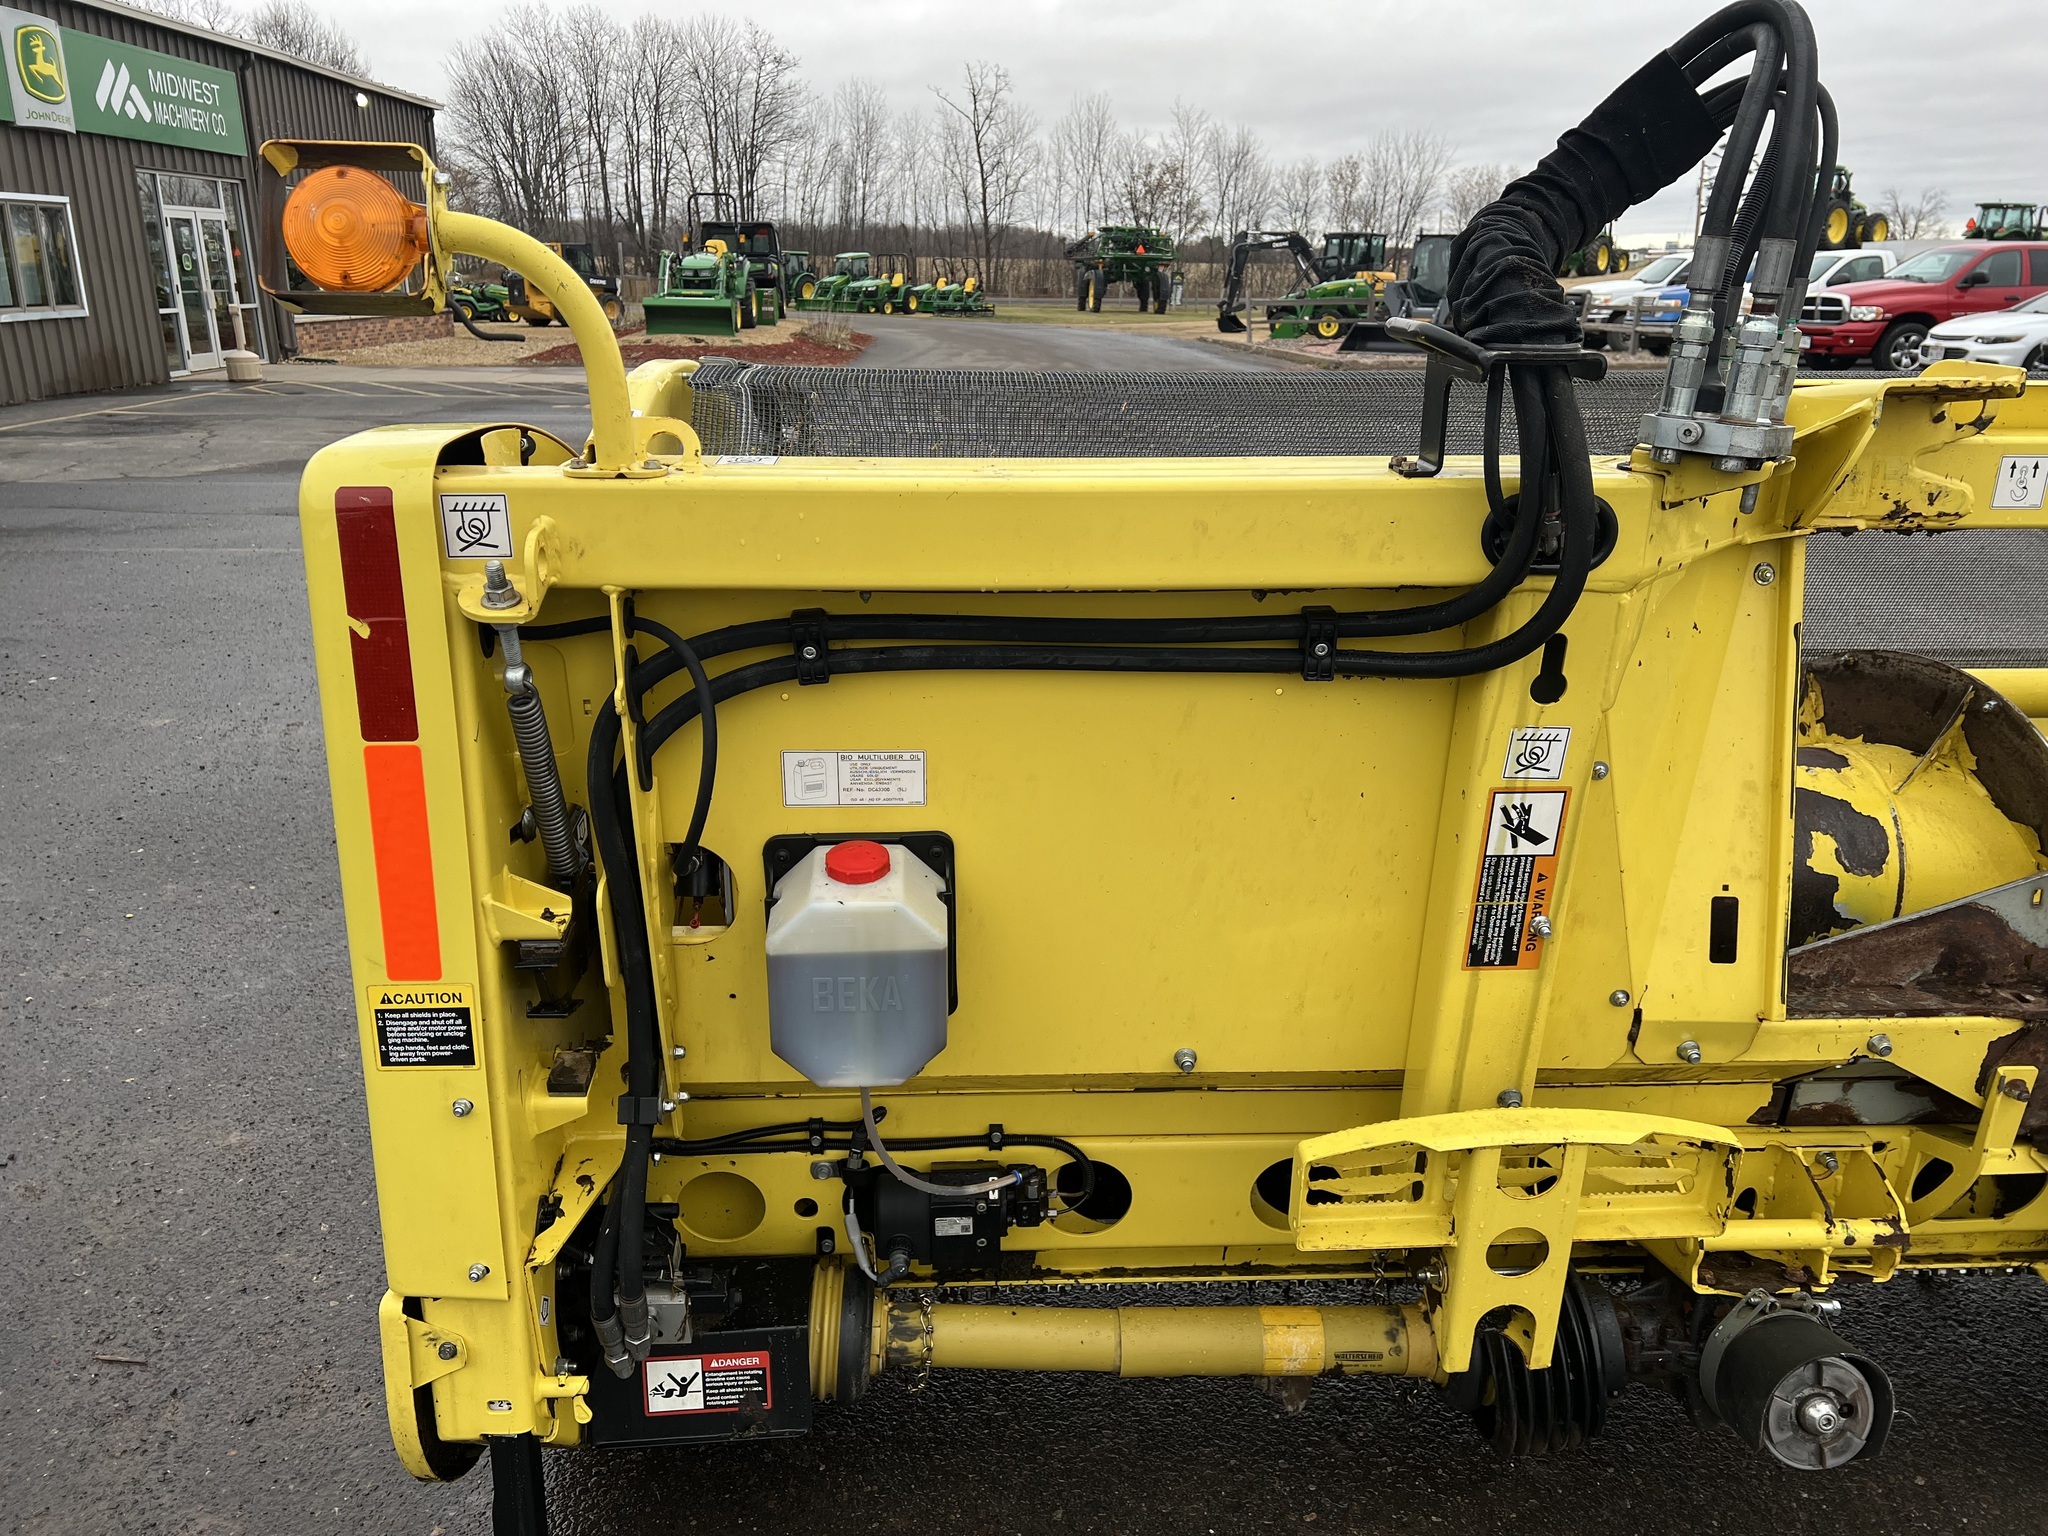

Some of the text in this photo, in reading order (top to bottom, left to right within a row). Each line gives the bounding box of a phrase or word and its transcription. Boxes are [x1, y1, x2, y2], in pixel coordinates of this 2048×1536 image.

[148, 68, 220, 106] MIDWEST
[25, 108, 50, 121] JOHN
[152, 100, 228, 136] MACHINERY CO.
[1525, 888, 1545, 951] WARNG
[393, 992, 462, 1004] CAUTION
[812, 976, 903, 1012] BEKA
[719, 1357, 759, 1366] DANGER
